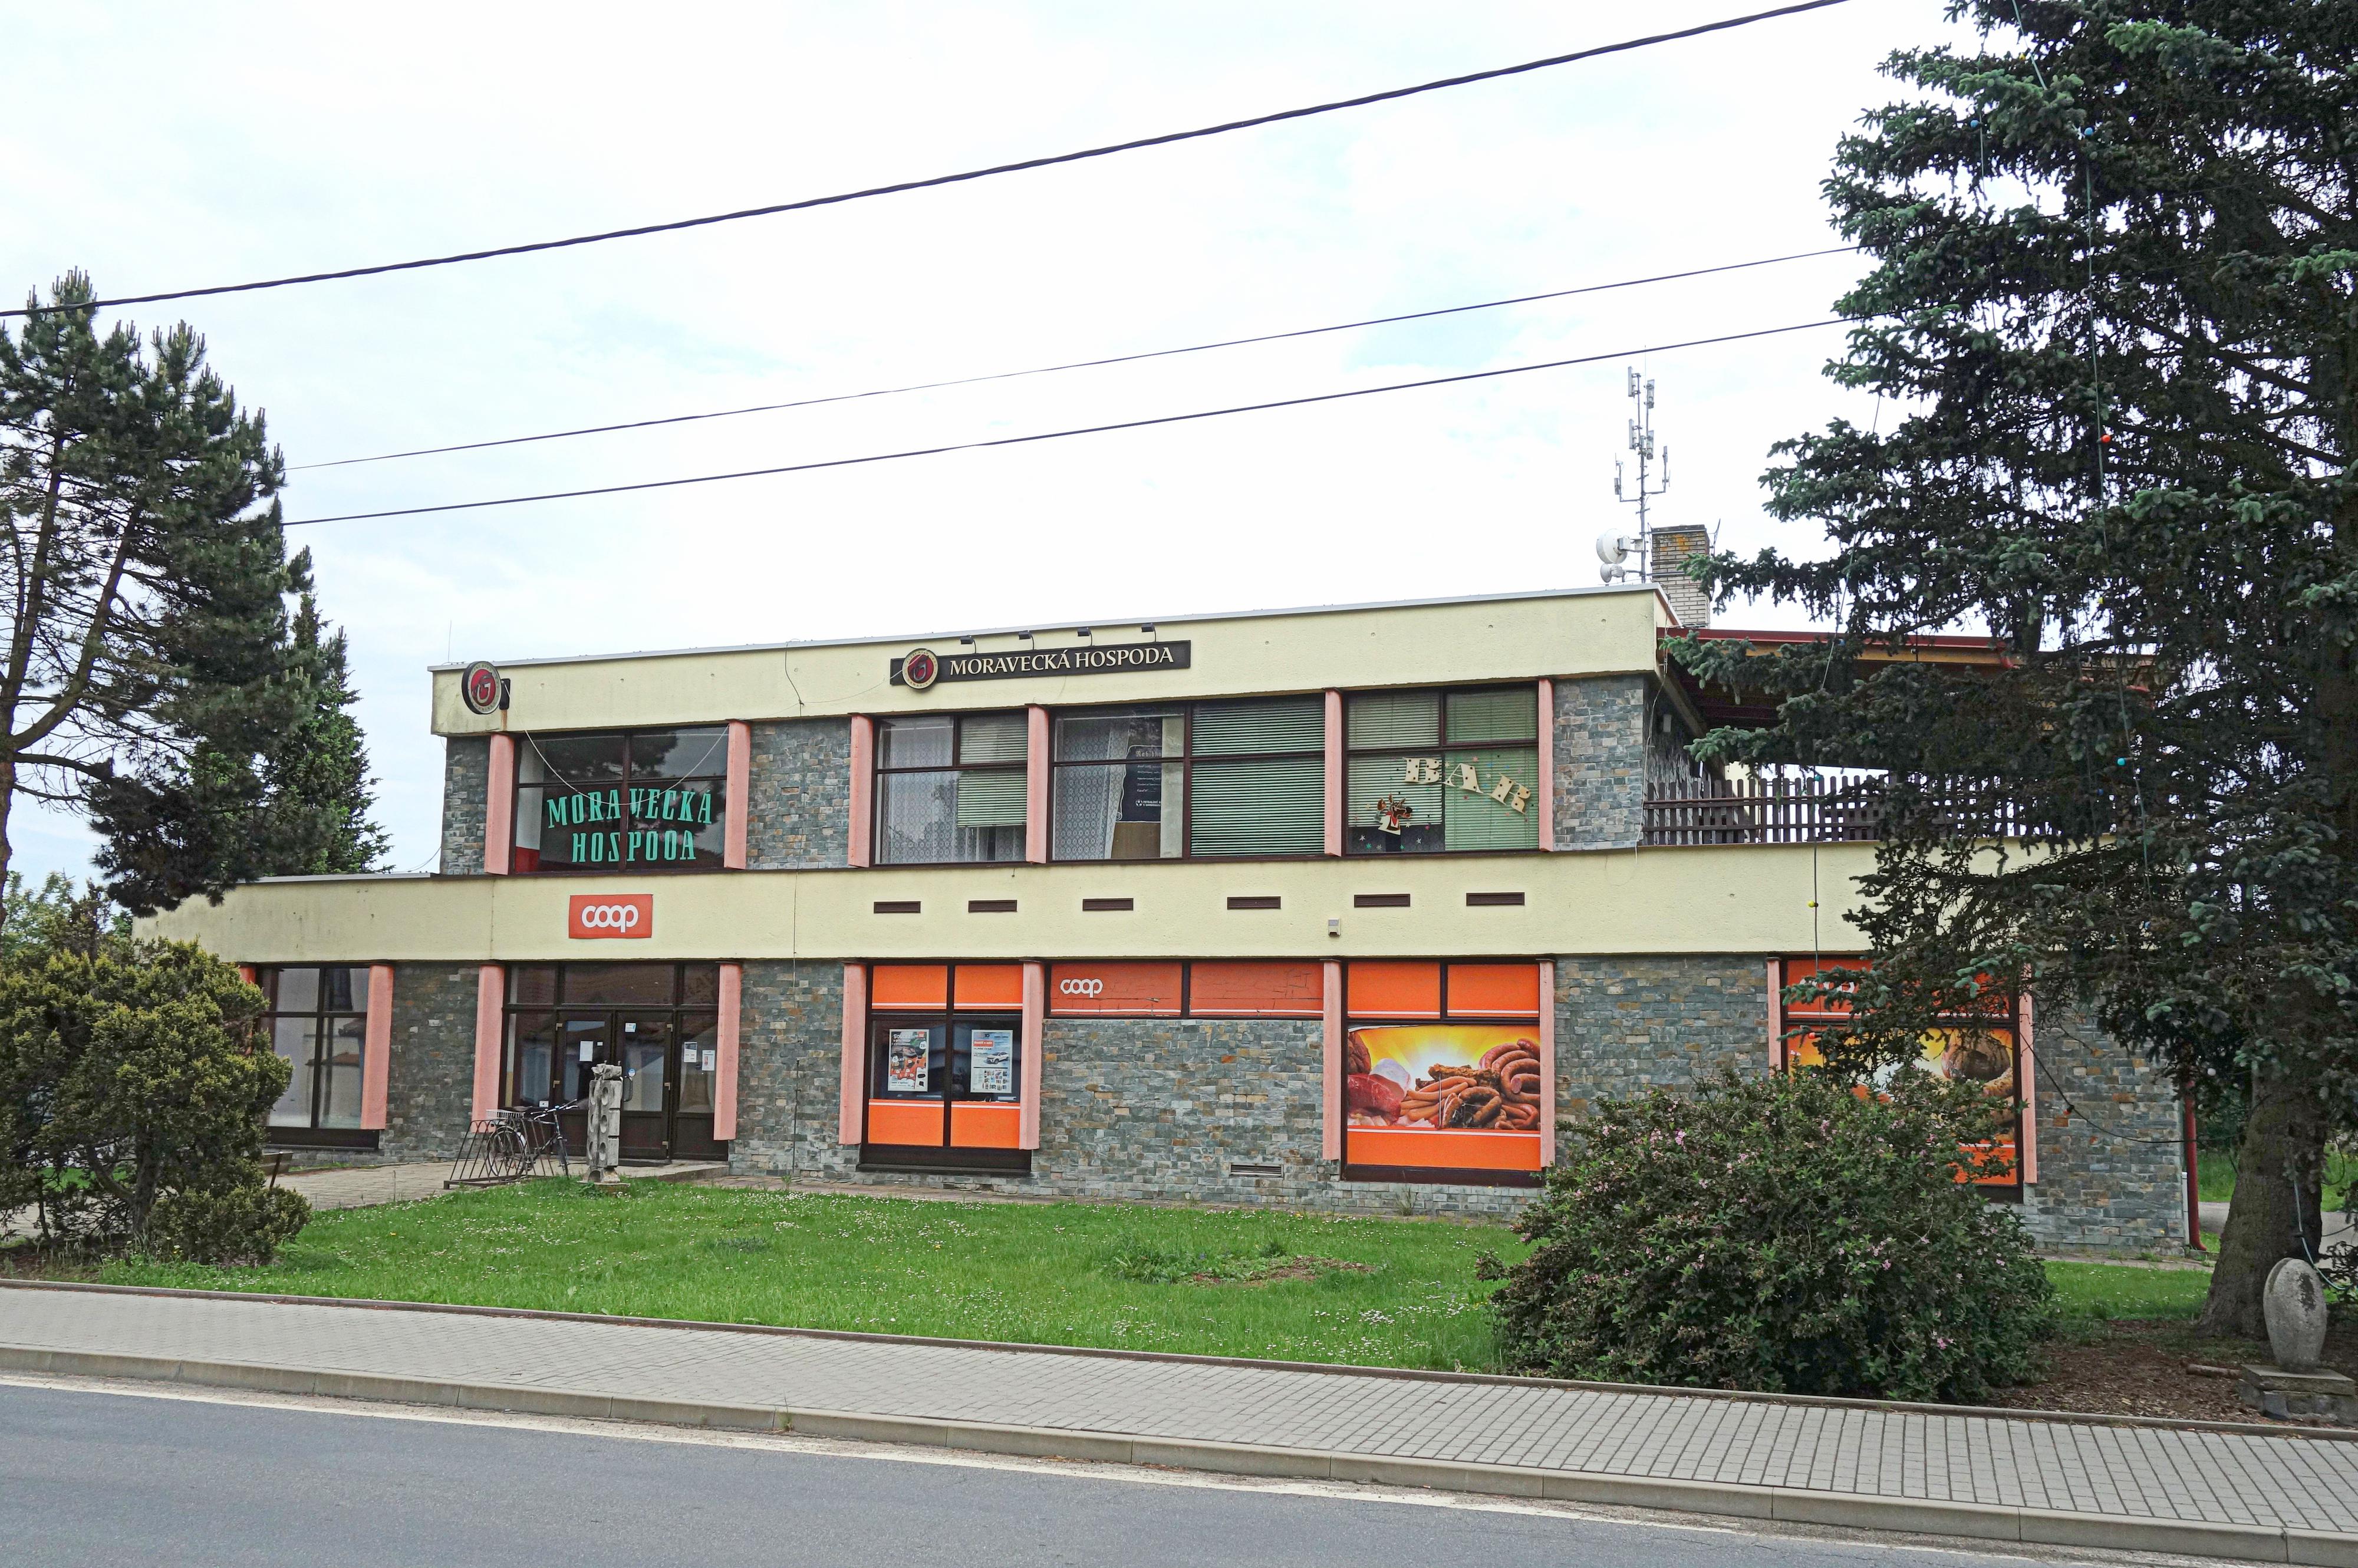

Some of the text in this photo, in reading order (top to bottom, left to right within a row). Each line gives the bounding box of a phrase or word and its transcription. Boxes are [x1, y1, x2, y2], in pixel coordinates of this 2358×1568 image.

[950, 649, 1070, 676] MORAVECKÁ
[1075, 647, 1174, 669] HOSPODA
[1402, 757, 1532, 814] BAR
[546, 789, 712, 829] MORAVECKÁ
[581, 904, 638, 933] coop
[1060, 979, 1104, 998] coop
